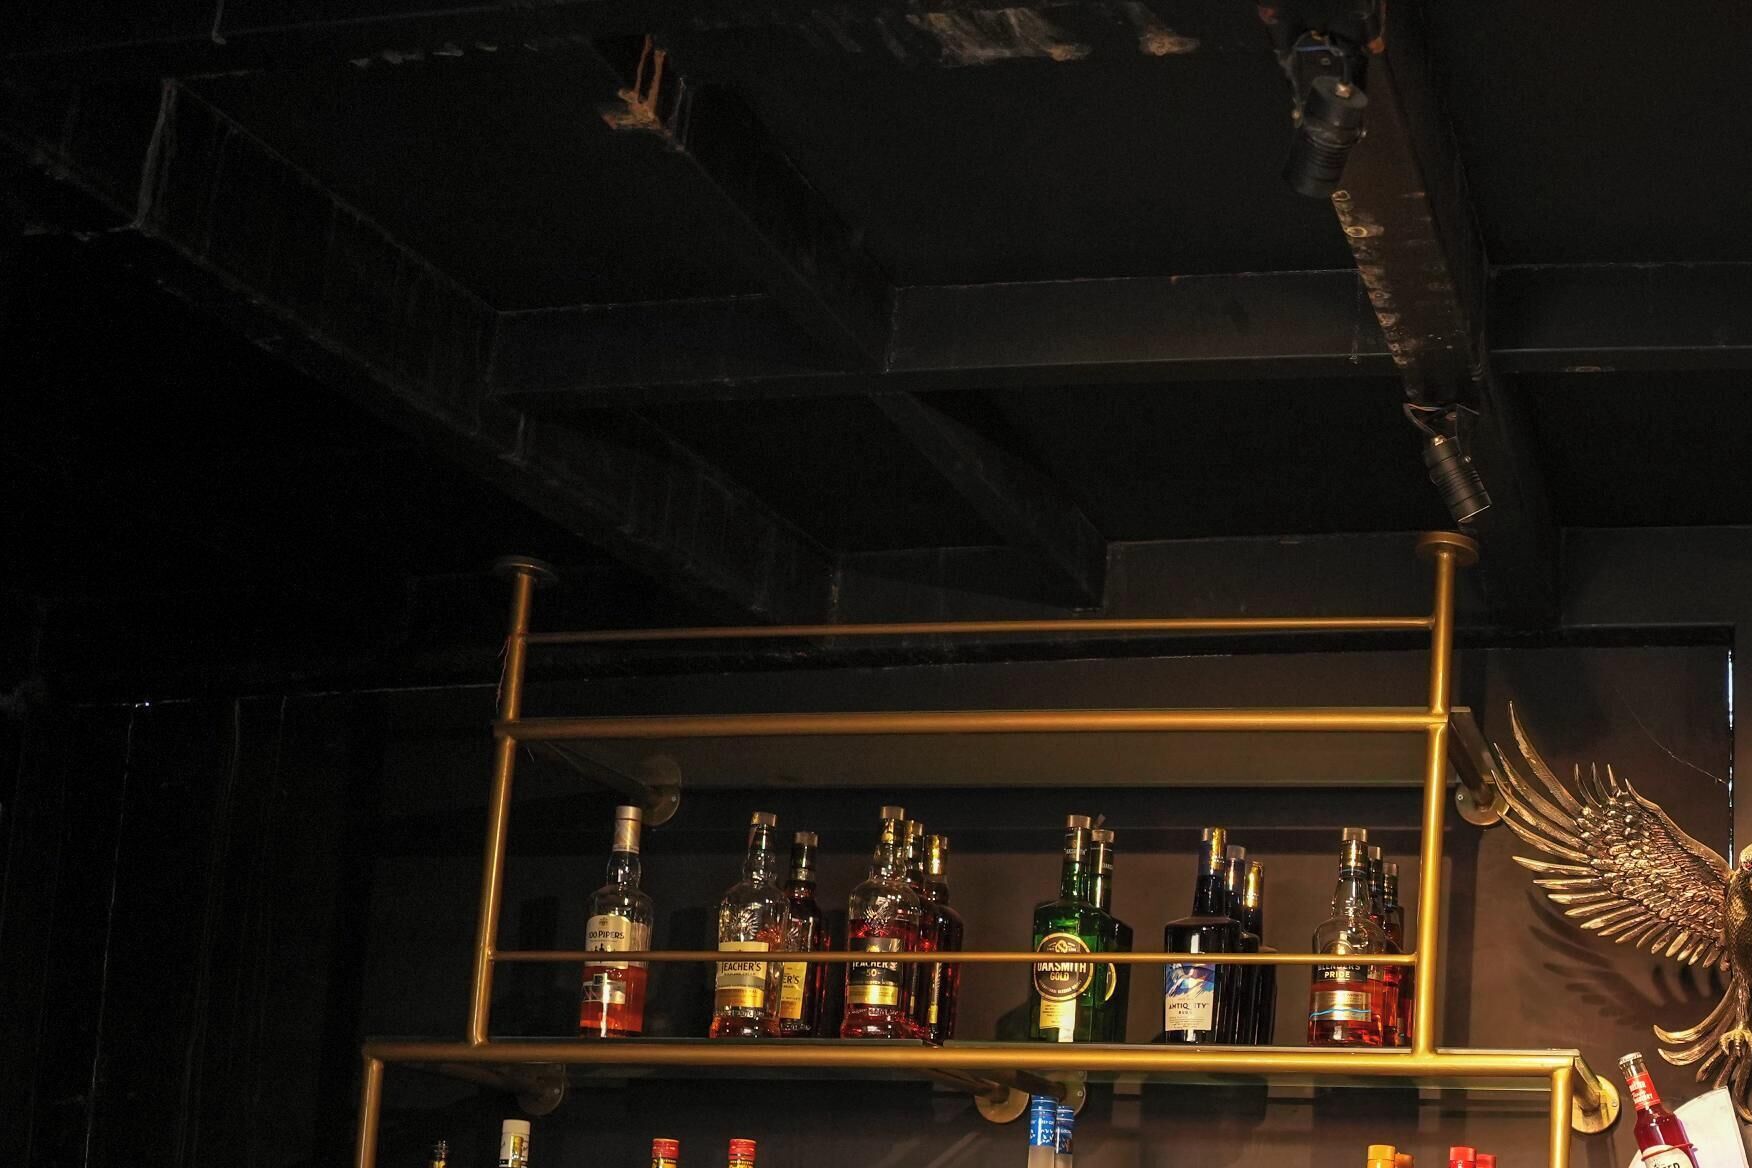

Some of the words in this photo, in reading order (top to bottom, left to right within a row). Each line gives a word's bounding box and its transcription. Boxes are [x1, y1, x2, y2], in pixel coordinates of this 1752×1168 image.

[599, 930, 624, 940] PIPERS
[1049, 972, 1069, 981] GOLD
[1324, 971, 1350, 979] PRIDE
